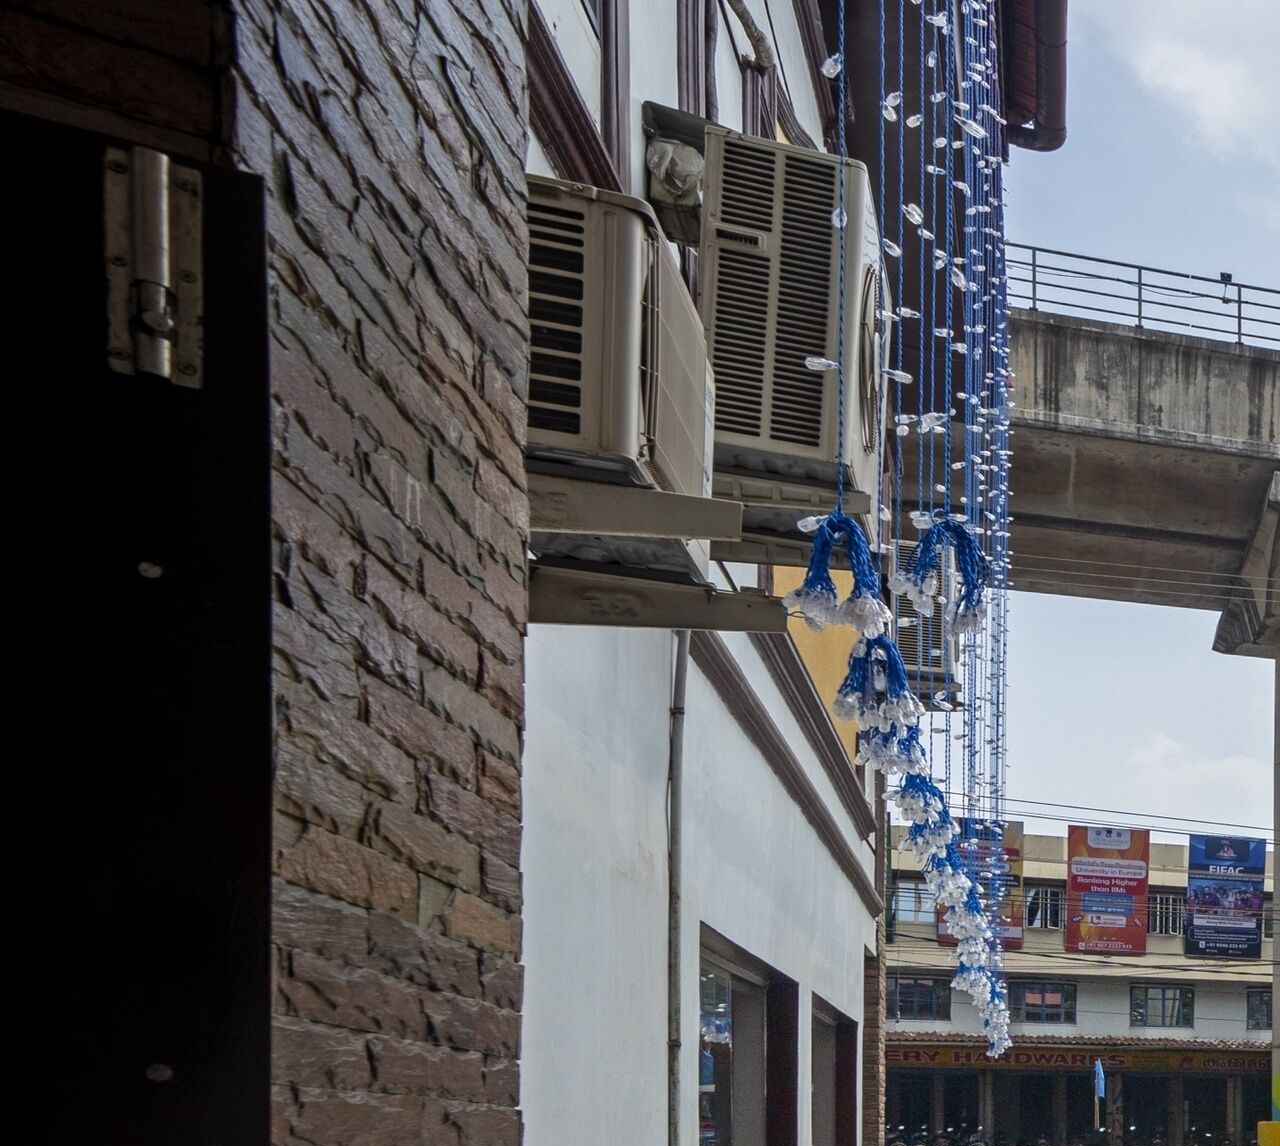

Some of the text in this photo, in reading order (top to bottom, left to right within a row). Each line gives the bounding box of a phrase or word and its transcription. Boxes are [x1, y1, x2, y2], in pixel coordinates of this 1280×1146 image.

[1076, 867, 1109, 875] University
[1118, 869, 1143, 877] Europe
[1077, 876, 1138, 887] Ranking Higher
[953, 1050, 1126, 1066] HARDWARES
